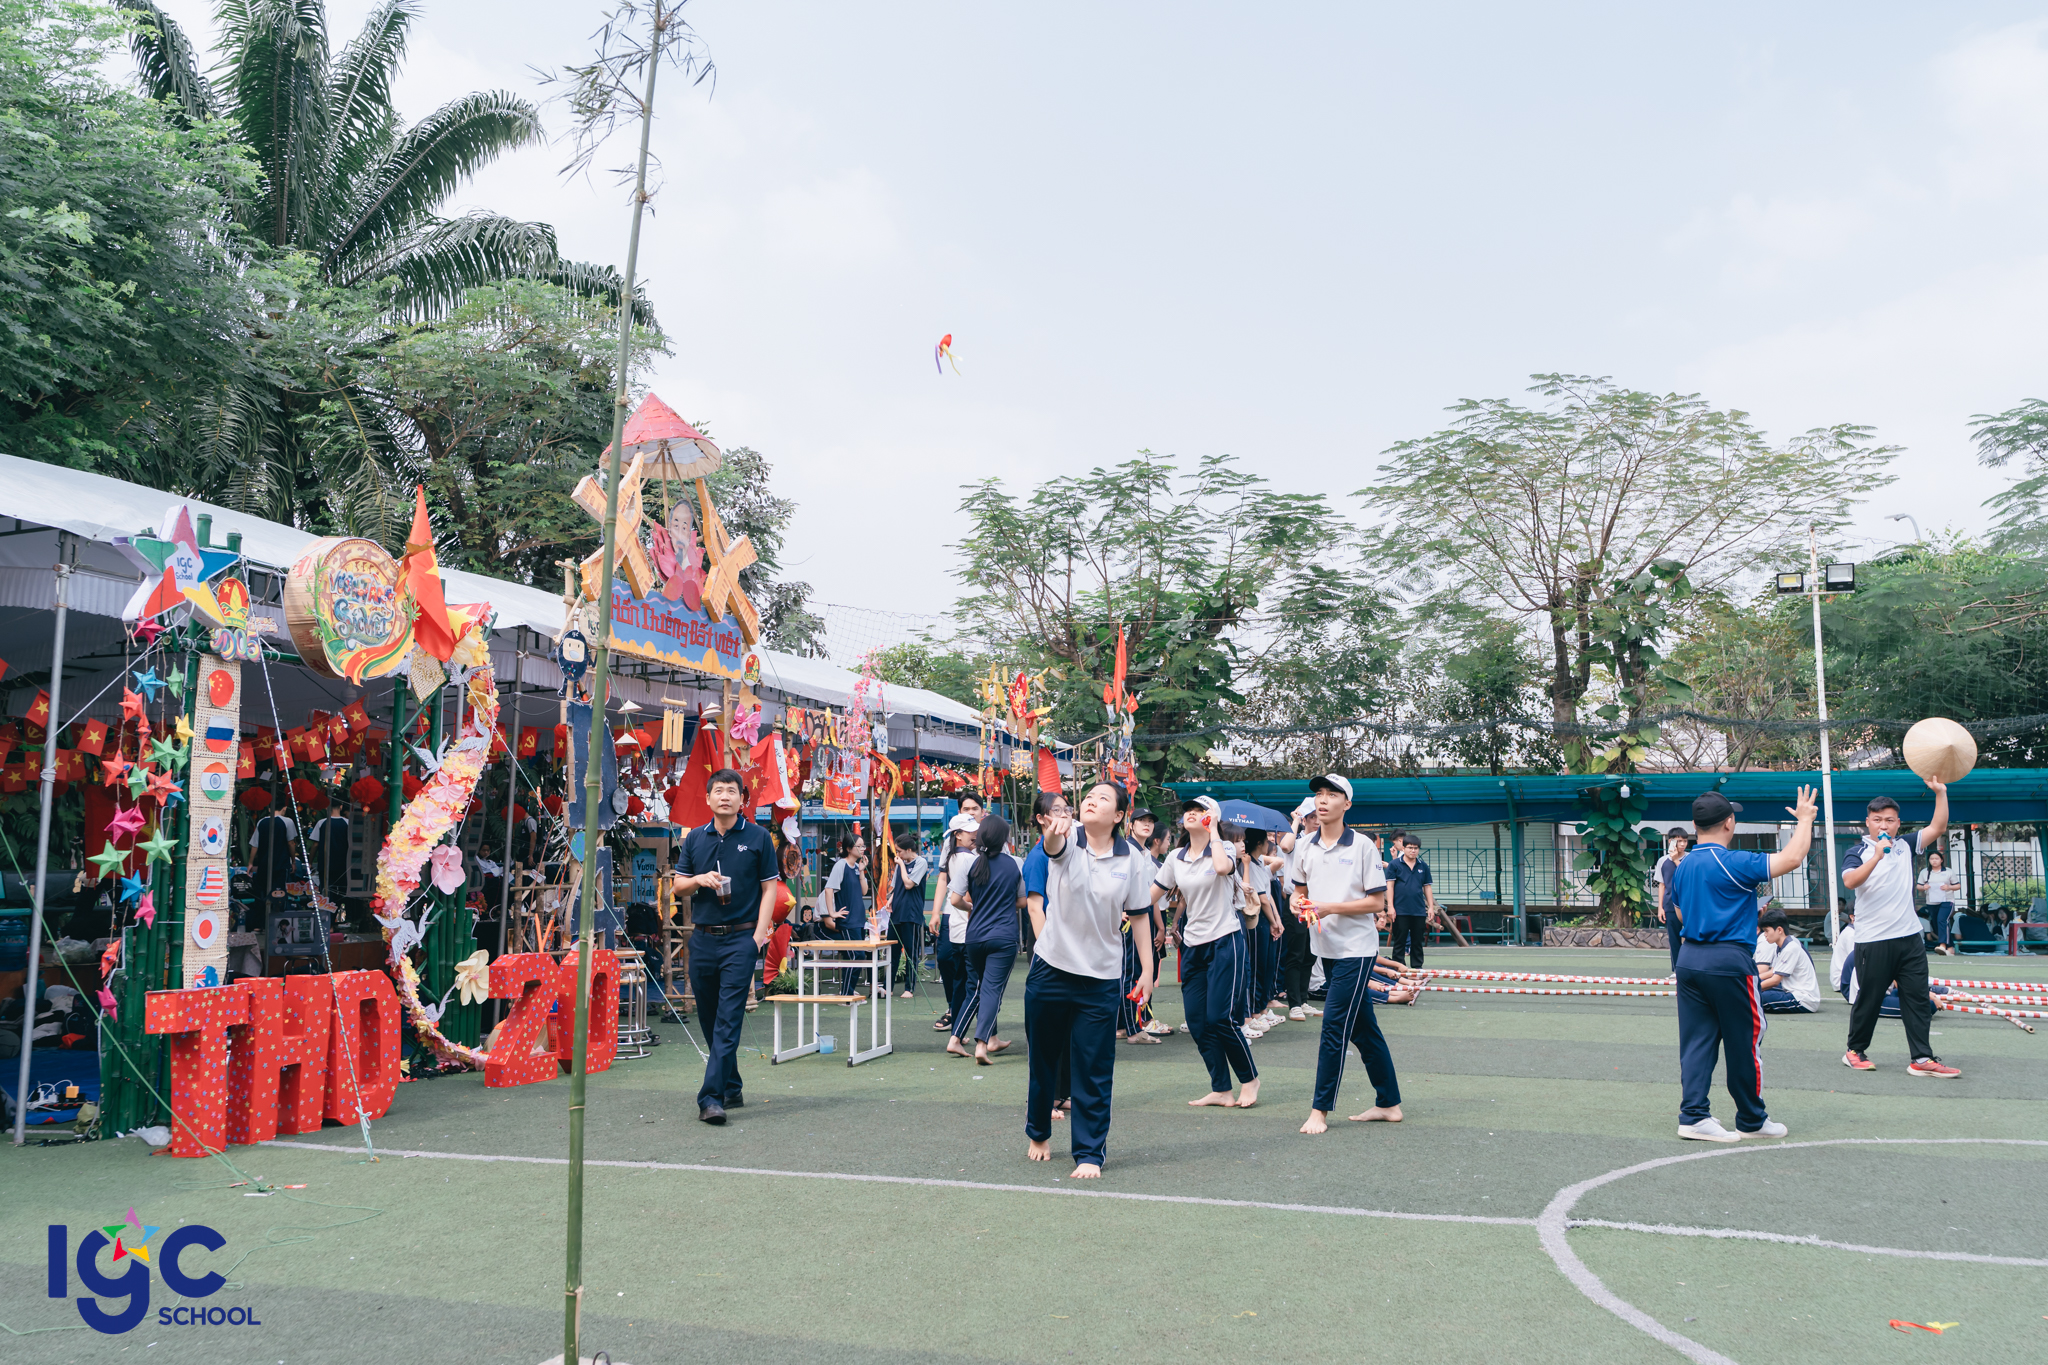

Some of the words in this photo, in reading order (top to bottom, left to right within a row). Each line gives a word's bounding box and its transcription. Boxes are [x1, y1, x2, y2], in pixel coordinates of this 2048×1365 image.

[175, 572, 194, 581] School
[1228, 817, 1255, 825] VIETNAM
[145, 968, 401, 1158] THD
